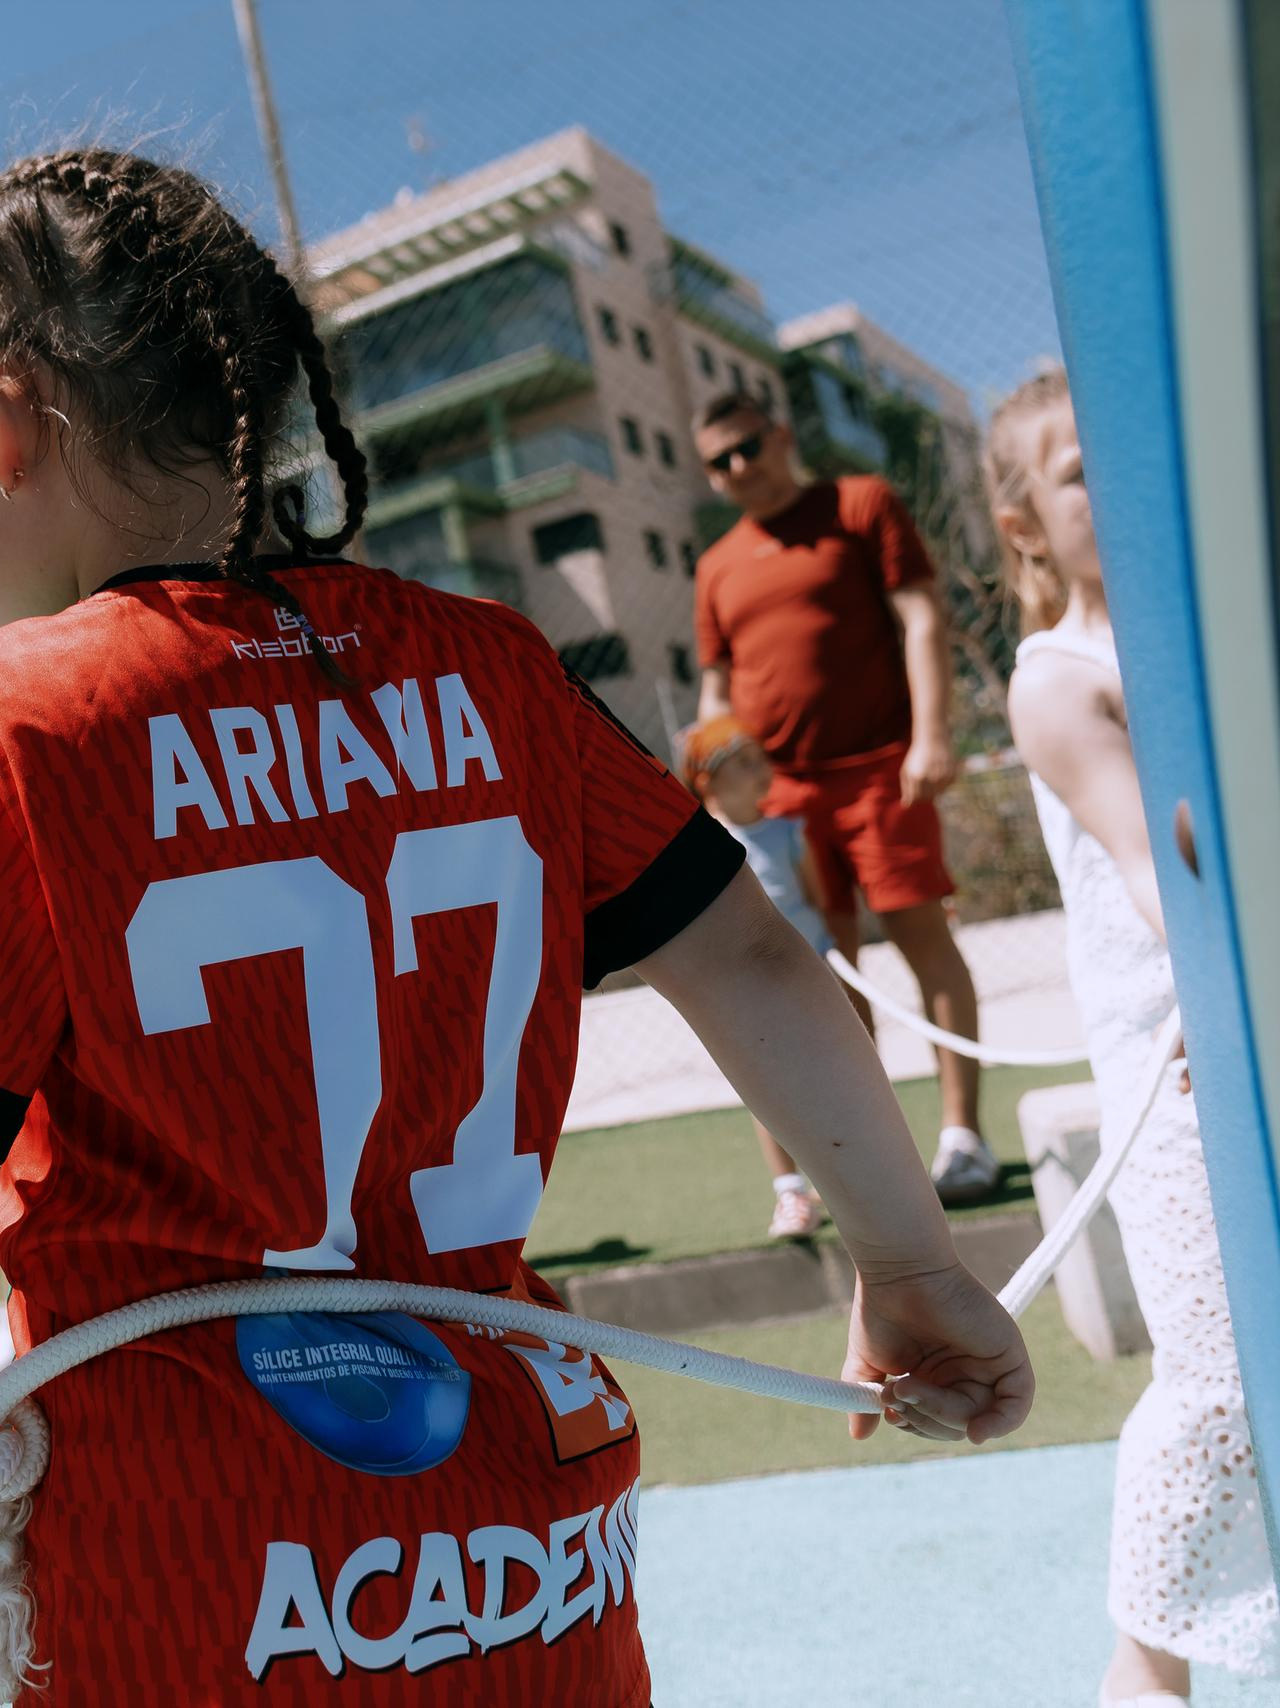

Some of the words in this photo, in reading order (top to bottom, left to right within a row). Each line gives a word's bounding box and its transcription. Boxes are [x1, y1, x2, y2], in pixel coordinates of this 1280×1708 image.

[148, 673, 504, 840] ARIANA
[125, 815, 544, 1270] 77
[252, 1347, 303, 1370] SÍLICE
[304, 1342, 375, 1366] INTEGRAL
[256, 1367, 337, 1385] MANTENIMIENTOS
[338, 1363, 350, 1377] DE
[351, 1363, 382, 1377] PISCINA
[245, 1475, 641, 1684] ACADEM
